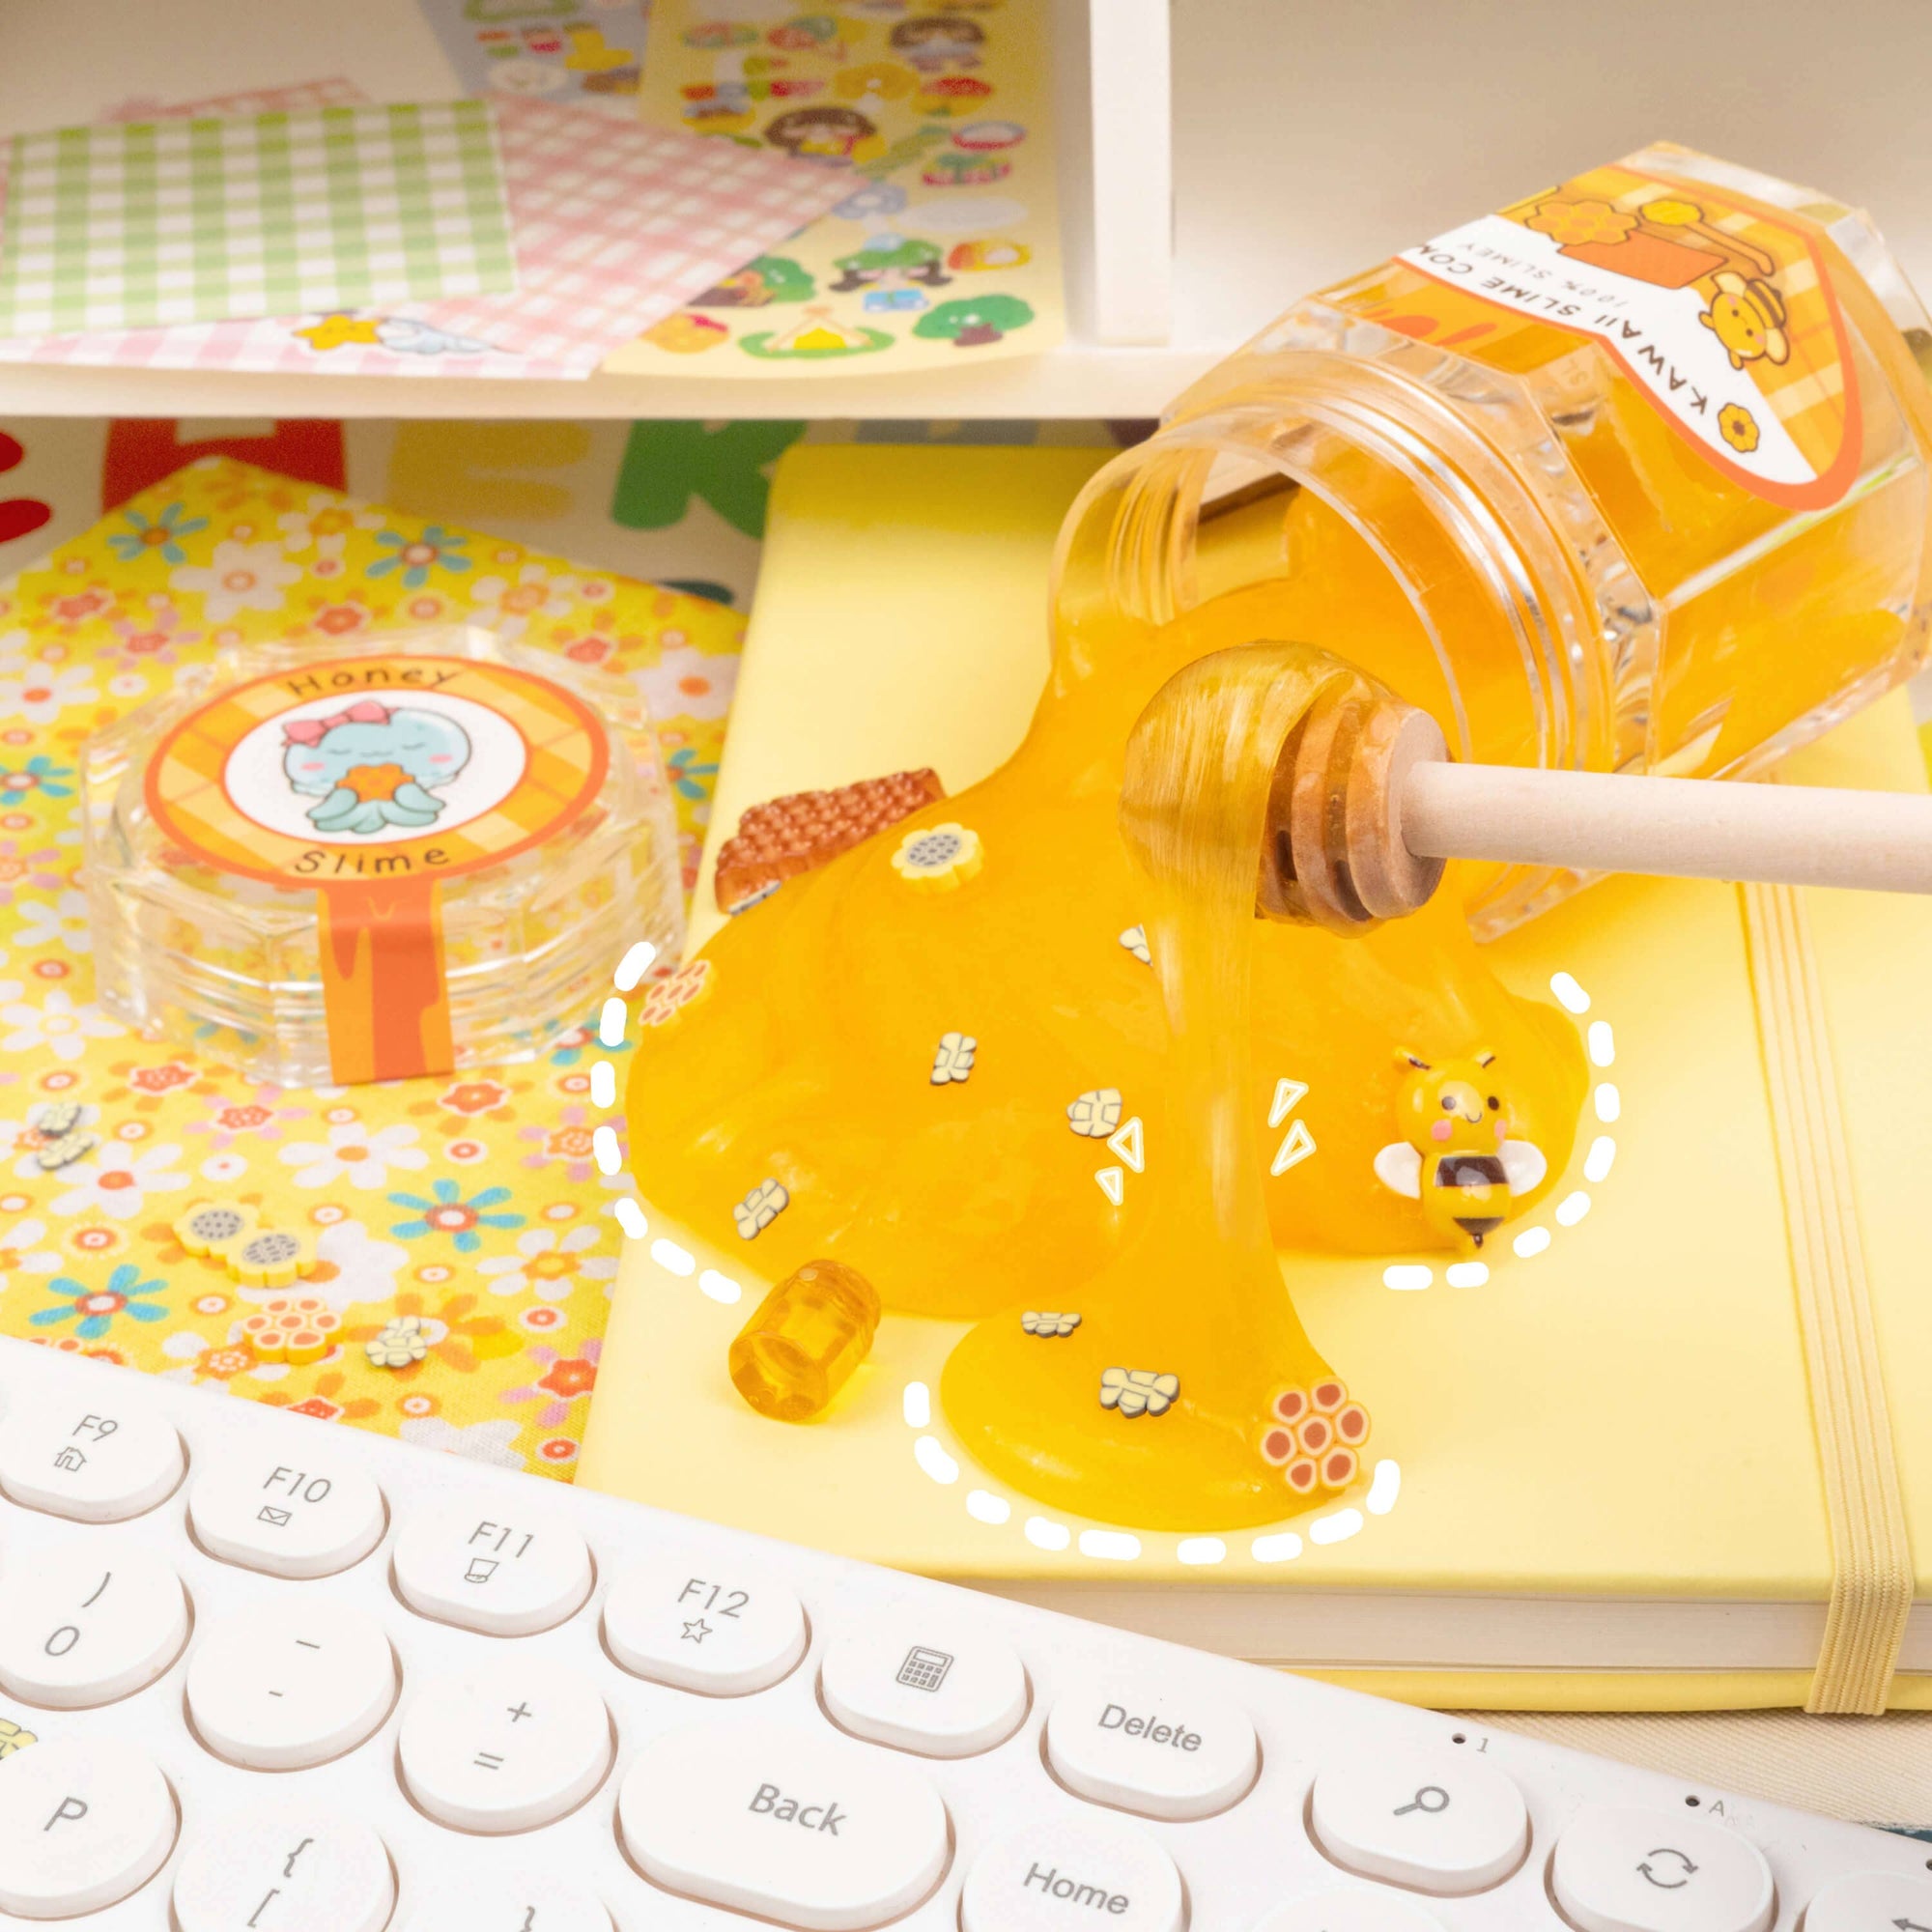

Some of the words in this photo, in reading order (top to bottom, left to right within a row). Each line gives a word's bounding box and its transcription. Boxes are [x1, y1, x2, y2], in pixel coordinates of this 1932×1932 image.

[1481, 276, 1581, 317] SLIME
[1561, 280, 1629, 307] 100%
[1594, 314, 1708, 415] KAWAII
[287, 668, 462, 696] Honey
[294, 847, 451, 874] Slime
[71, 1413, 119, 1442] F9
[262, 1465, 332, 1503] F10
[468, 1520, 534, 1559] F11
[677, 1577, 750, 1619] F12
[1097, 1703, 1203, 1752] Delete
[43, 1796, 89, 1833] P
[748, 1782, 847, 1836] Back
[1708, 1800, 1724, 1817] A
[1023, 1861, 1130, 1916] Home
